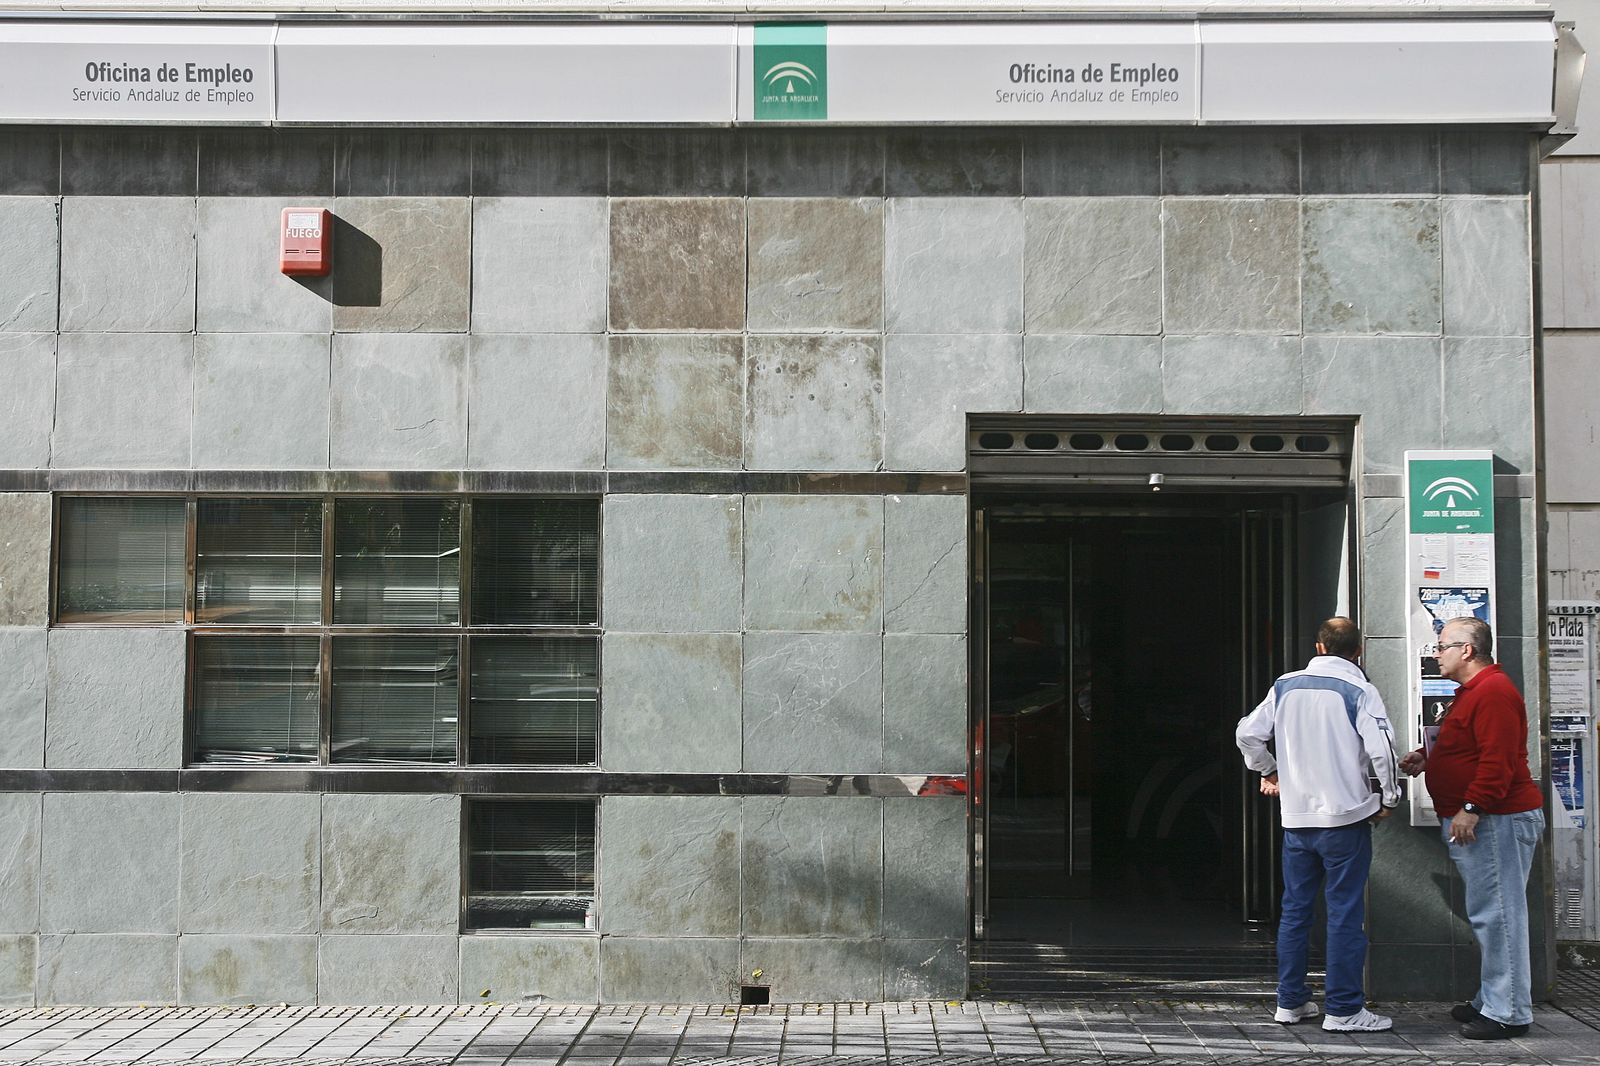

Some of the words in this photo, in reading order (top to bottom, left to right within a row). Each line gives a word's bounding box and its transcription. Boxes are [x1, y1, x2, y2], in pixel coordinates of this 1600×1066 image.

[85, 62, 151, 82] Oficina
[157, 62, 179, 82] de
[185, 63, 254, 87] Empleo
[1009, 63, 1075, 83] Oficina
[1081, 63, 1103, 83] de
[1110, 63, 1179, 87] Empleo
[72, 87, 121, 102] Servicio
[127, 88, 179, 102] Andaluz
[185, 88, 201, 102] de
[207, 88, 254, 105] Empleo
[995, 89, 1044, 103] Servicio
[1050, 88, 1103, 102] Andaluz
[1109, 88, 1125, 102] de
[1131, 88, 1179, 105] Empleo
[285, 228, 321, 238] FUEGO
[1559, 617, 1583, 637] Plata
